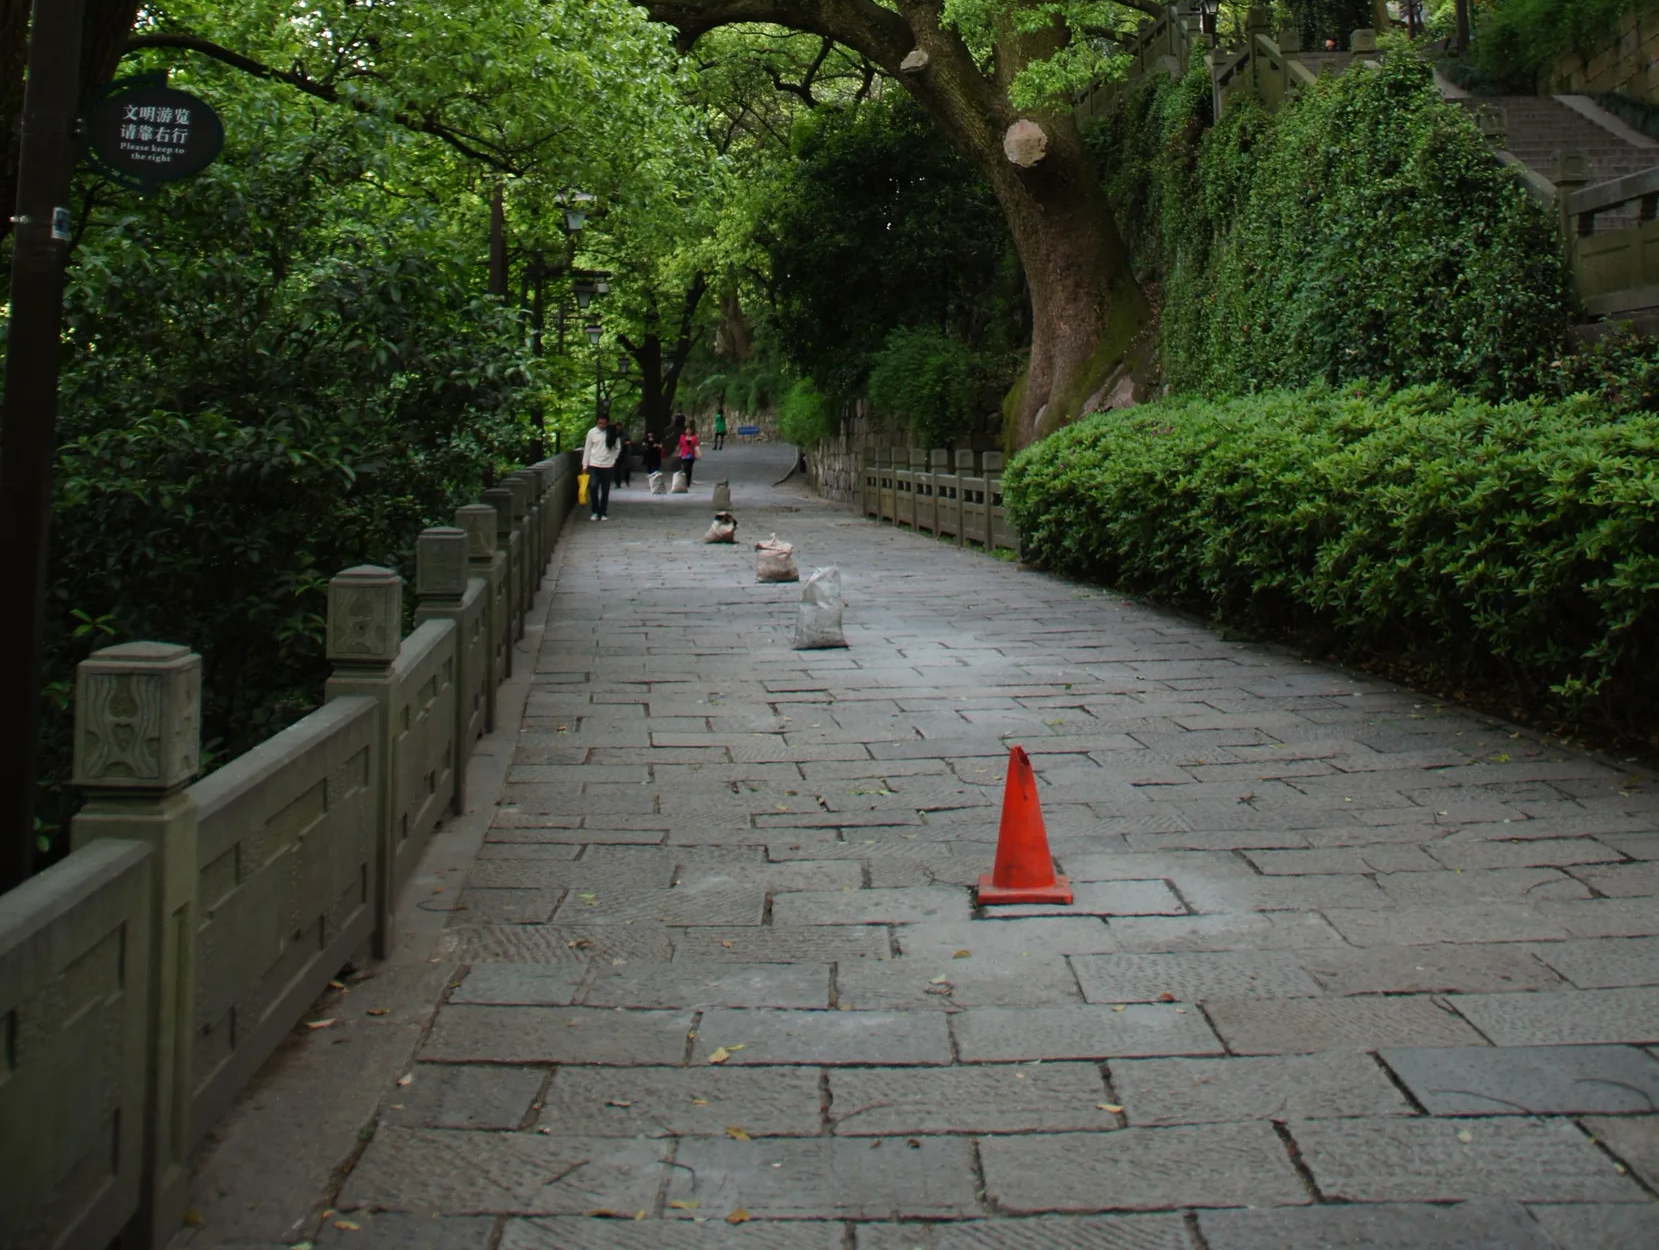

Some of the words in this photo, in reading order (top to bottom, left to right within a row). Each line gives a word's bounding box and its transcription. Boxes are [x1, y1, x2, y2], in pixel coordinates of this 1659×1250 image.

[122, 105, 190, 125] 文明游览
[120, 124, 188, 144] 请靠右行
[120, 142, 149, 151] Please
[151, 144, 173, 154] keep
[131, 152, 146, 160] the
[147, 154, 171, 164] right
